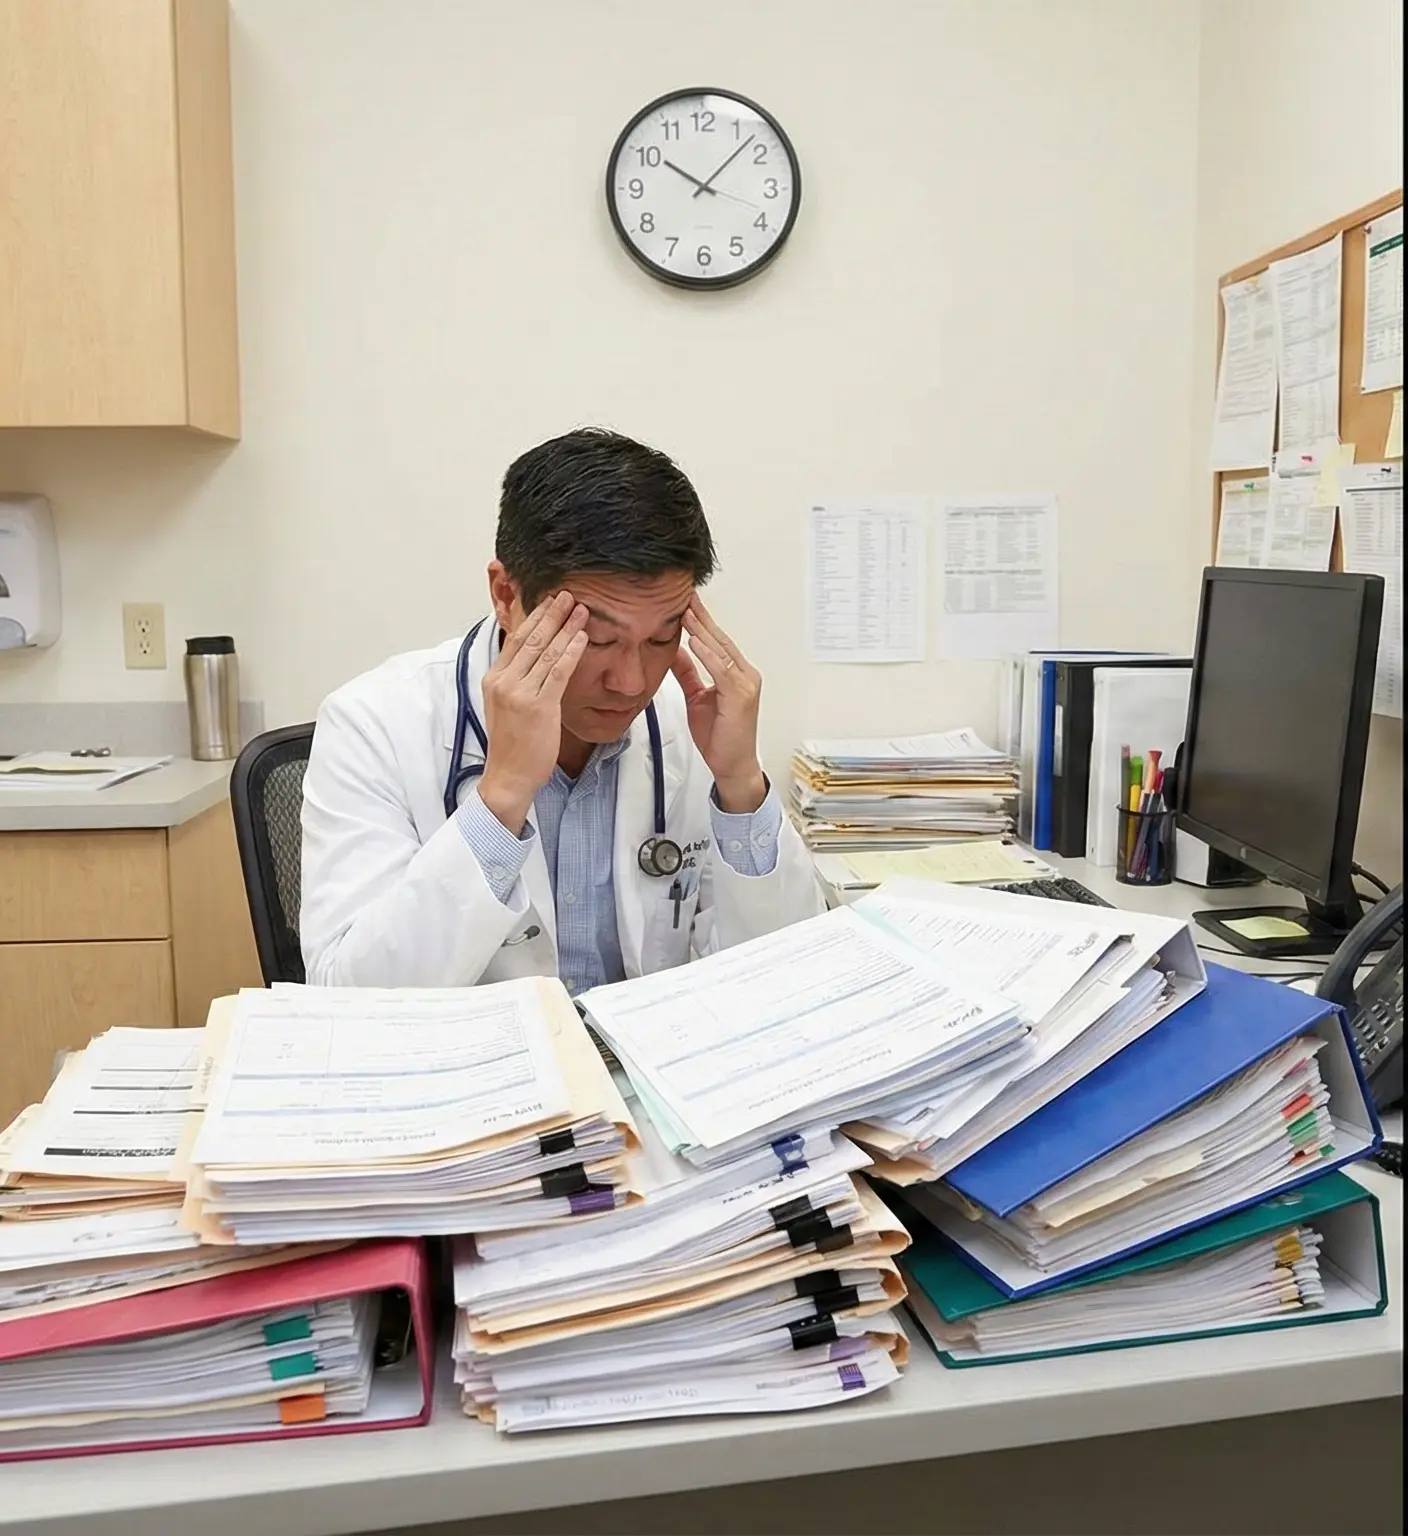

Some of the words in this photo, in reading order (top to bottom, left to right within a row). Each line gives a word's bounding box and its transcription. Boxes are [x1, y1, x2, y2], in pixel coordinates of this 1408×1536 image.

[661, 120, 680, 140] 11
[690, 111, 716, 132] 12
[731, 119, 740, 140] 1
[636, 146, 661, 168] 10
[753, 144, 768, 165] 2
[628, 178, 644, 199] 9
[763, 178, 779, 199] 3
[639, 212, 655, 233] 8
[753, 212, 768, 232] 4
[665, 237, 679, 257] 7
[696, 245, 712, 266] 6
[729, 236, 744, 256] 5
